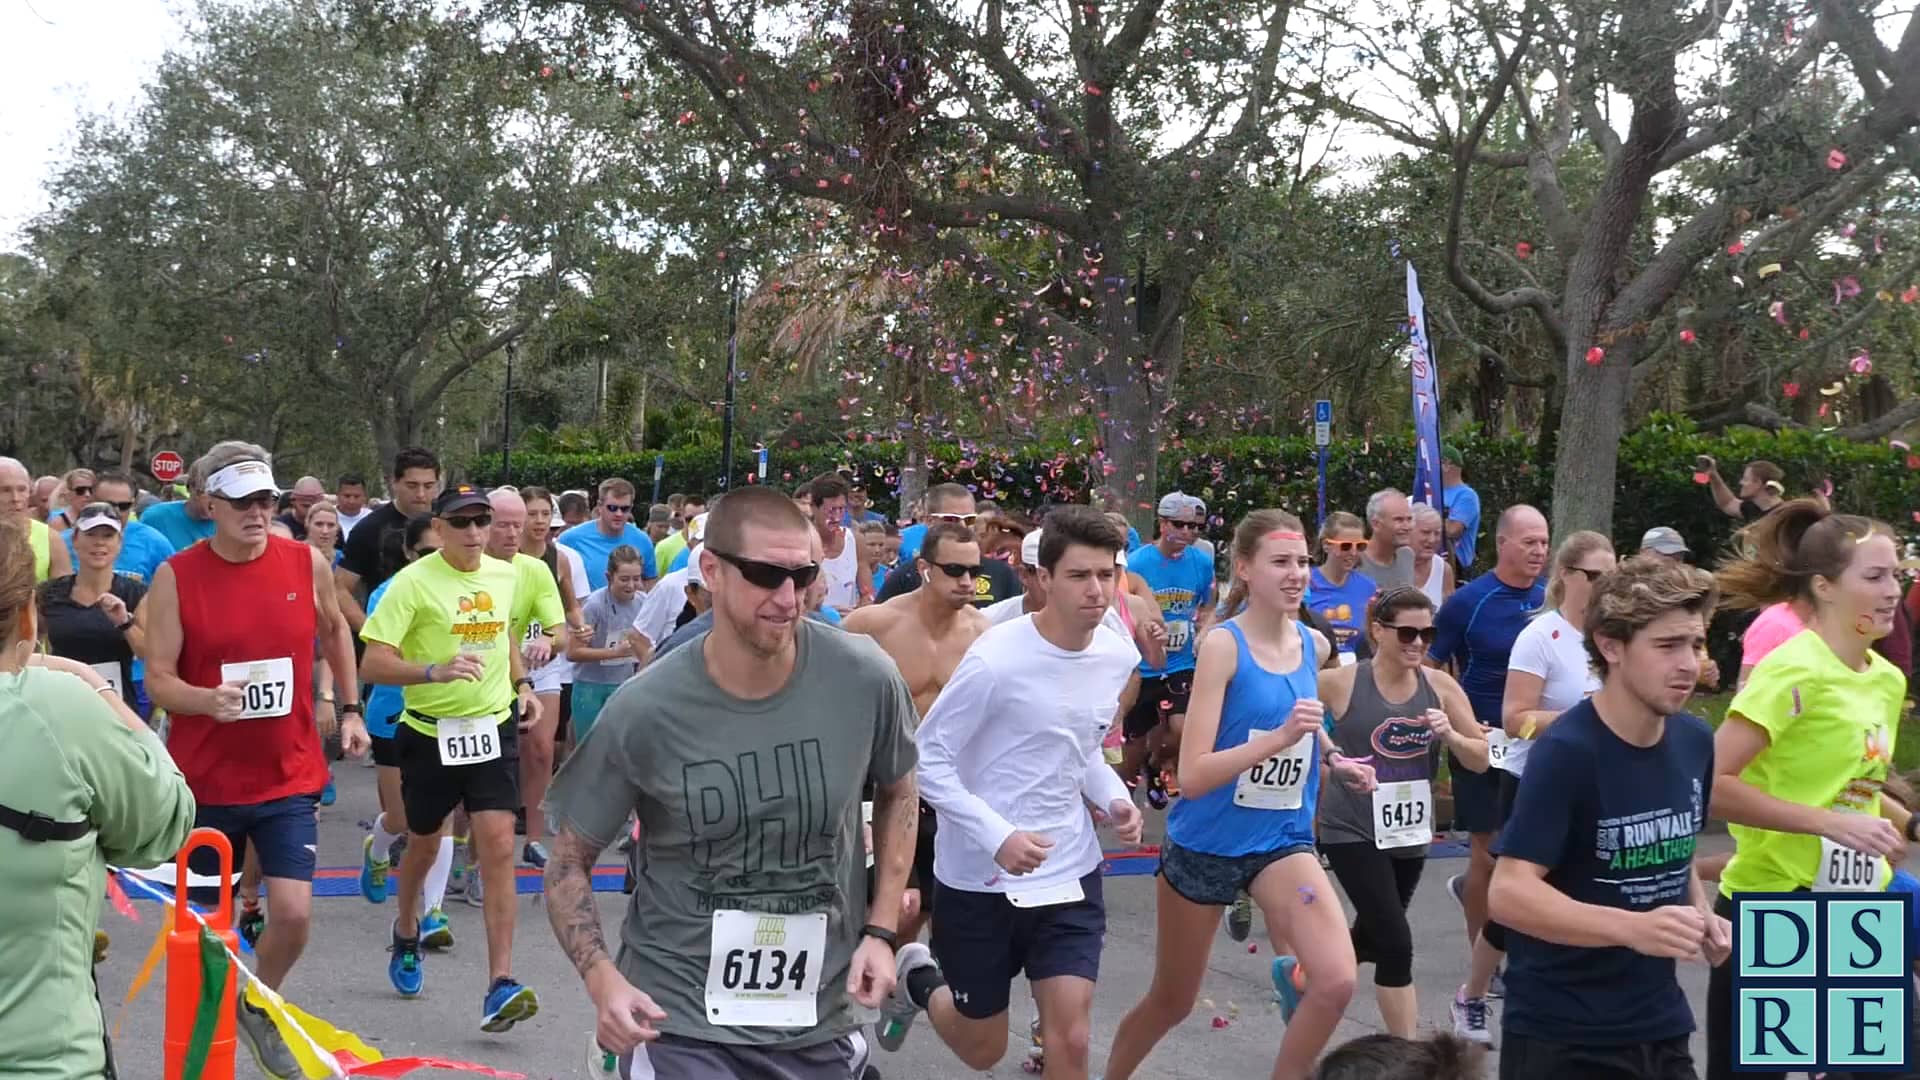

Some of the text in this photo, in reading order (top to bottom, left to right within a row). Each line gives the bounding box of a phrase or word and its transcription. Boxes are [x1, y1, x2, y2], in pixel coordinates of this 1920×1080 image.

[154, 460, 181, 472] STOP
[447, 734, 492, 759] 6118
[1250, 758, 1304, 786] 6205
[1382, 801, 1425, 828] 6413
[1609, 850, 1623, 871] A
[1829, 848, 1874, 886] 6166
[722, 948, 808, 991] 6134
